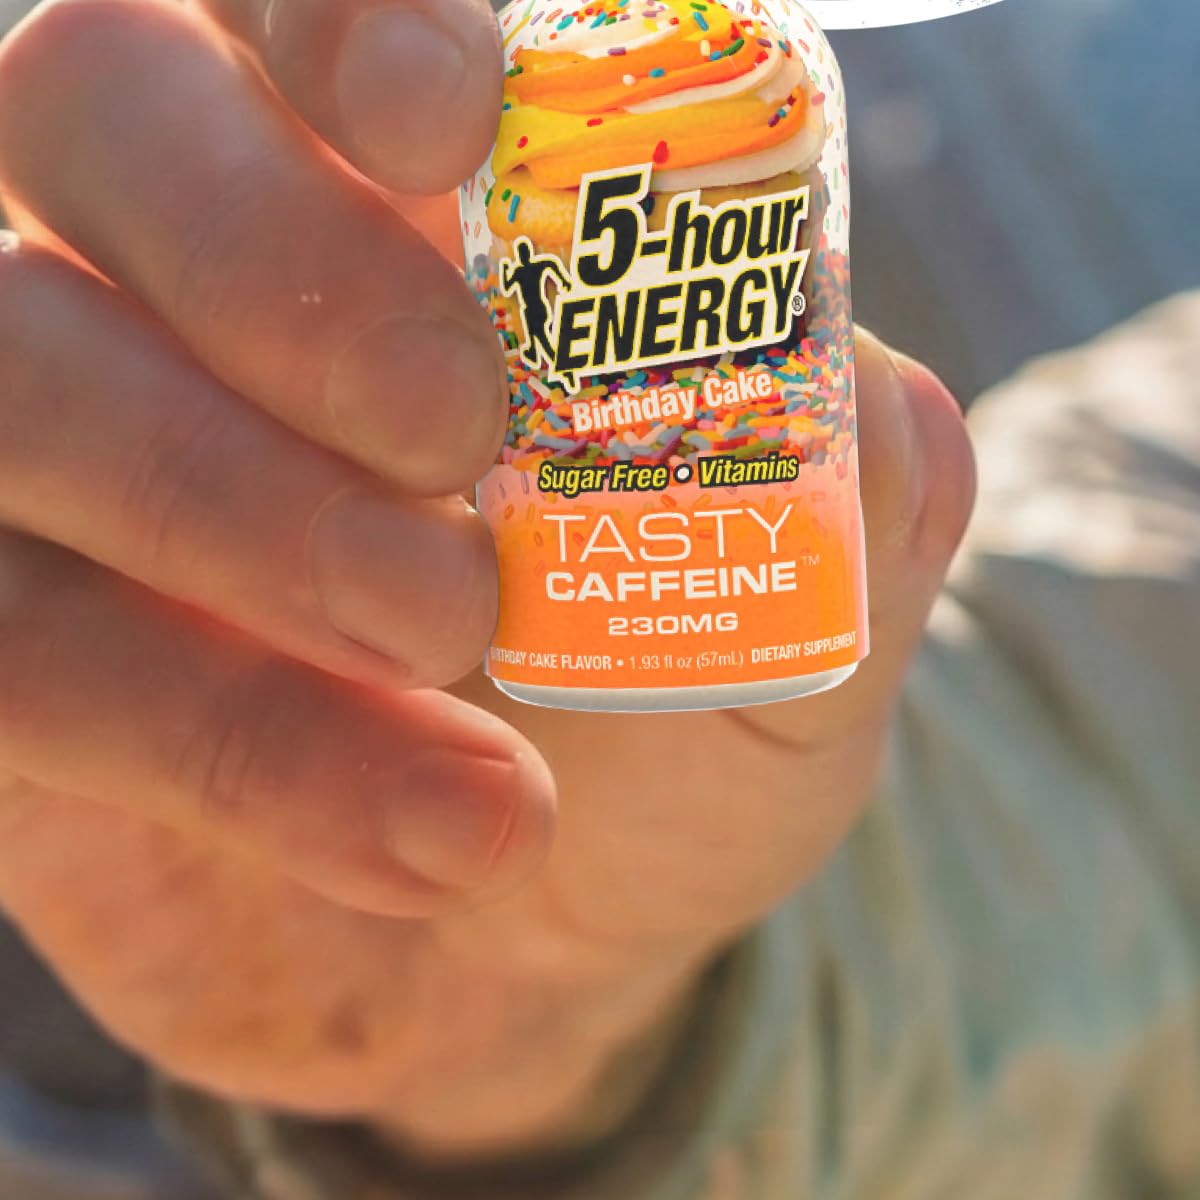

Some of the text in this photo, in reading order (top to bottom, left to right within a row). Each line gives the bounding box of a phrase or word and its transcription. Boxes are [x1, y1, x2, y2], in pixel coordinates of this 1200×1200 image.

[576, 172, 805, 288] 5-hour
[572, 373, 773, 433] Birthday Cake
[538, 455, 799, 496] Sugar Free Vitamins
[543, 504, 793, 563] TASTY
[545, 560, 797, 602] CAFFEINE
[608, 612, 739, 636] 230MG
[529, 652, 558, 669] CAKE
[561, 654, 612, 670] FLAVOR
[629, 654, 660, 670] 1.93
[663, 655, 673, 669] fl
[676, 658, 692, 668] oz
[751, 643, 801, 664] DIETARY
[803, 631, 857, 657] SUPPLEMENT
